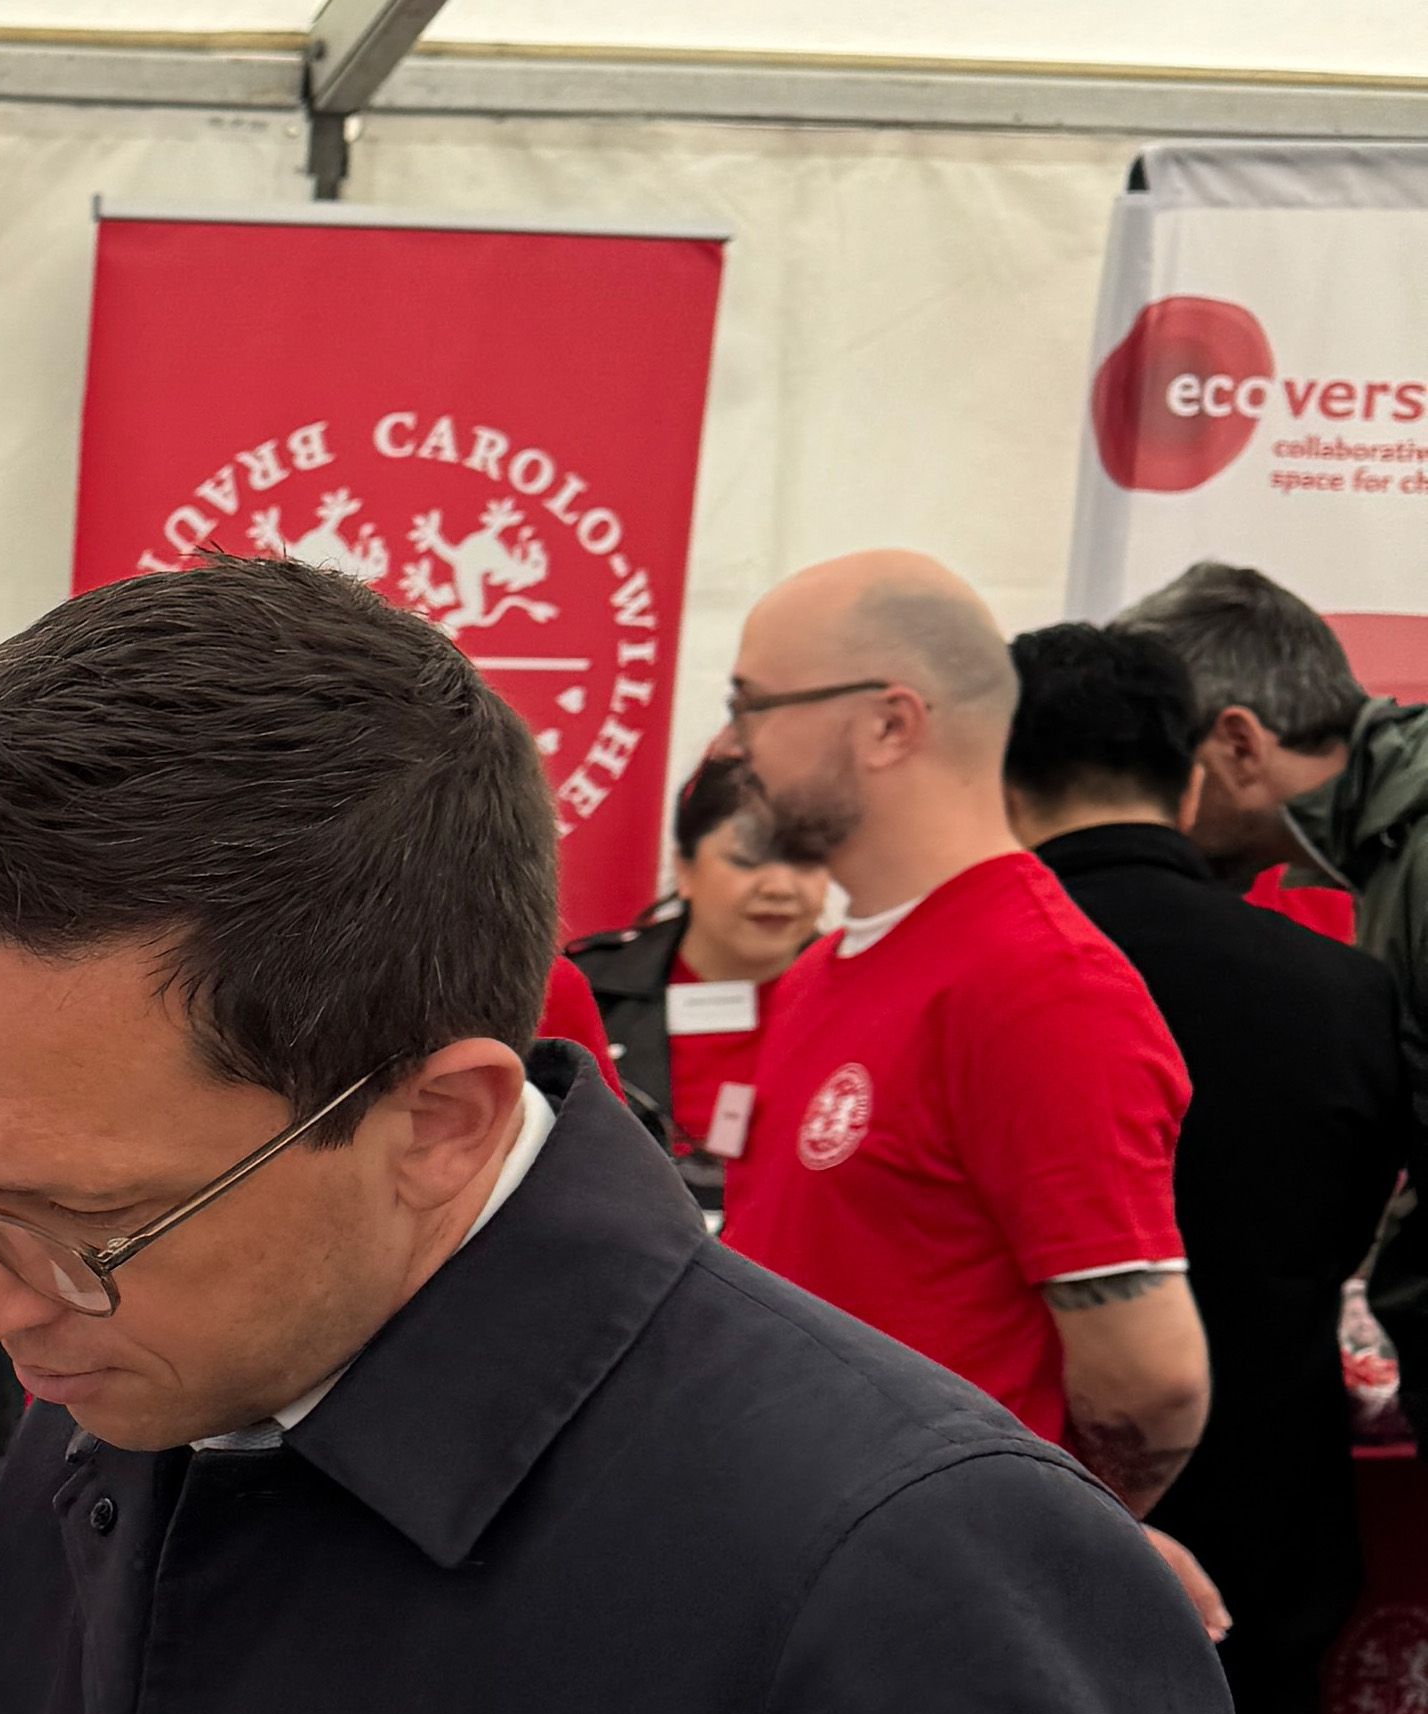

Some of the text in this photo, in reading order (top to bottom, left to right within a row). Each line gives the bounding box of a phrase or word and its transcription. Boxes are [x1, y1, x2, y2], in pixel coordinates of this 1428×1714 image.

[1271, 472, 1345, 496] space
[1351, 467, 1393, 494] for
[372, 412, 657, 838] CAROLO-WILHE
